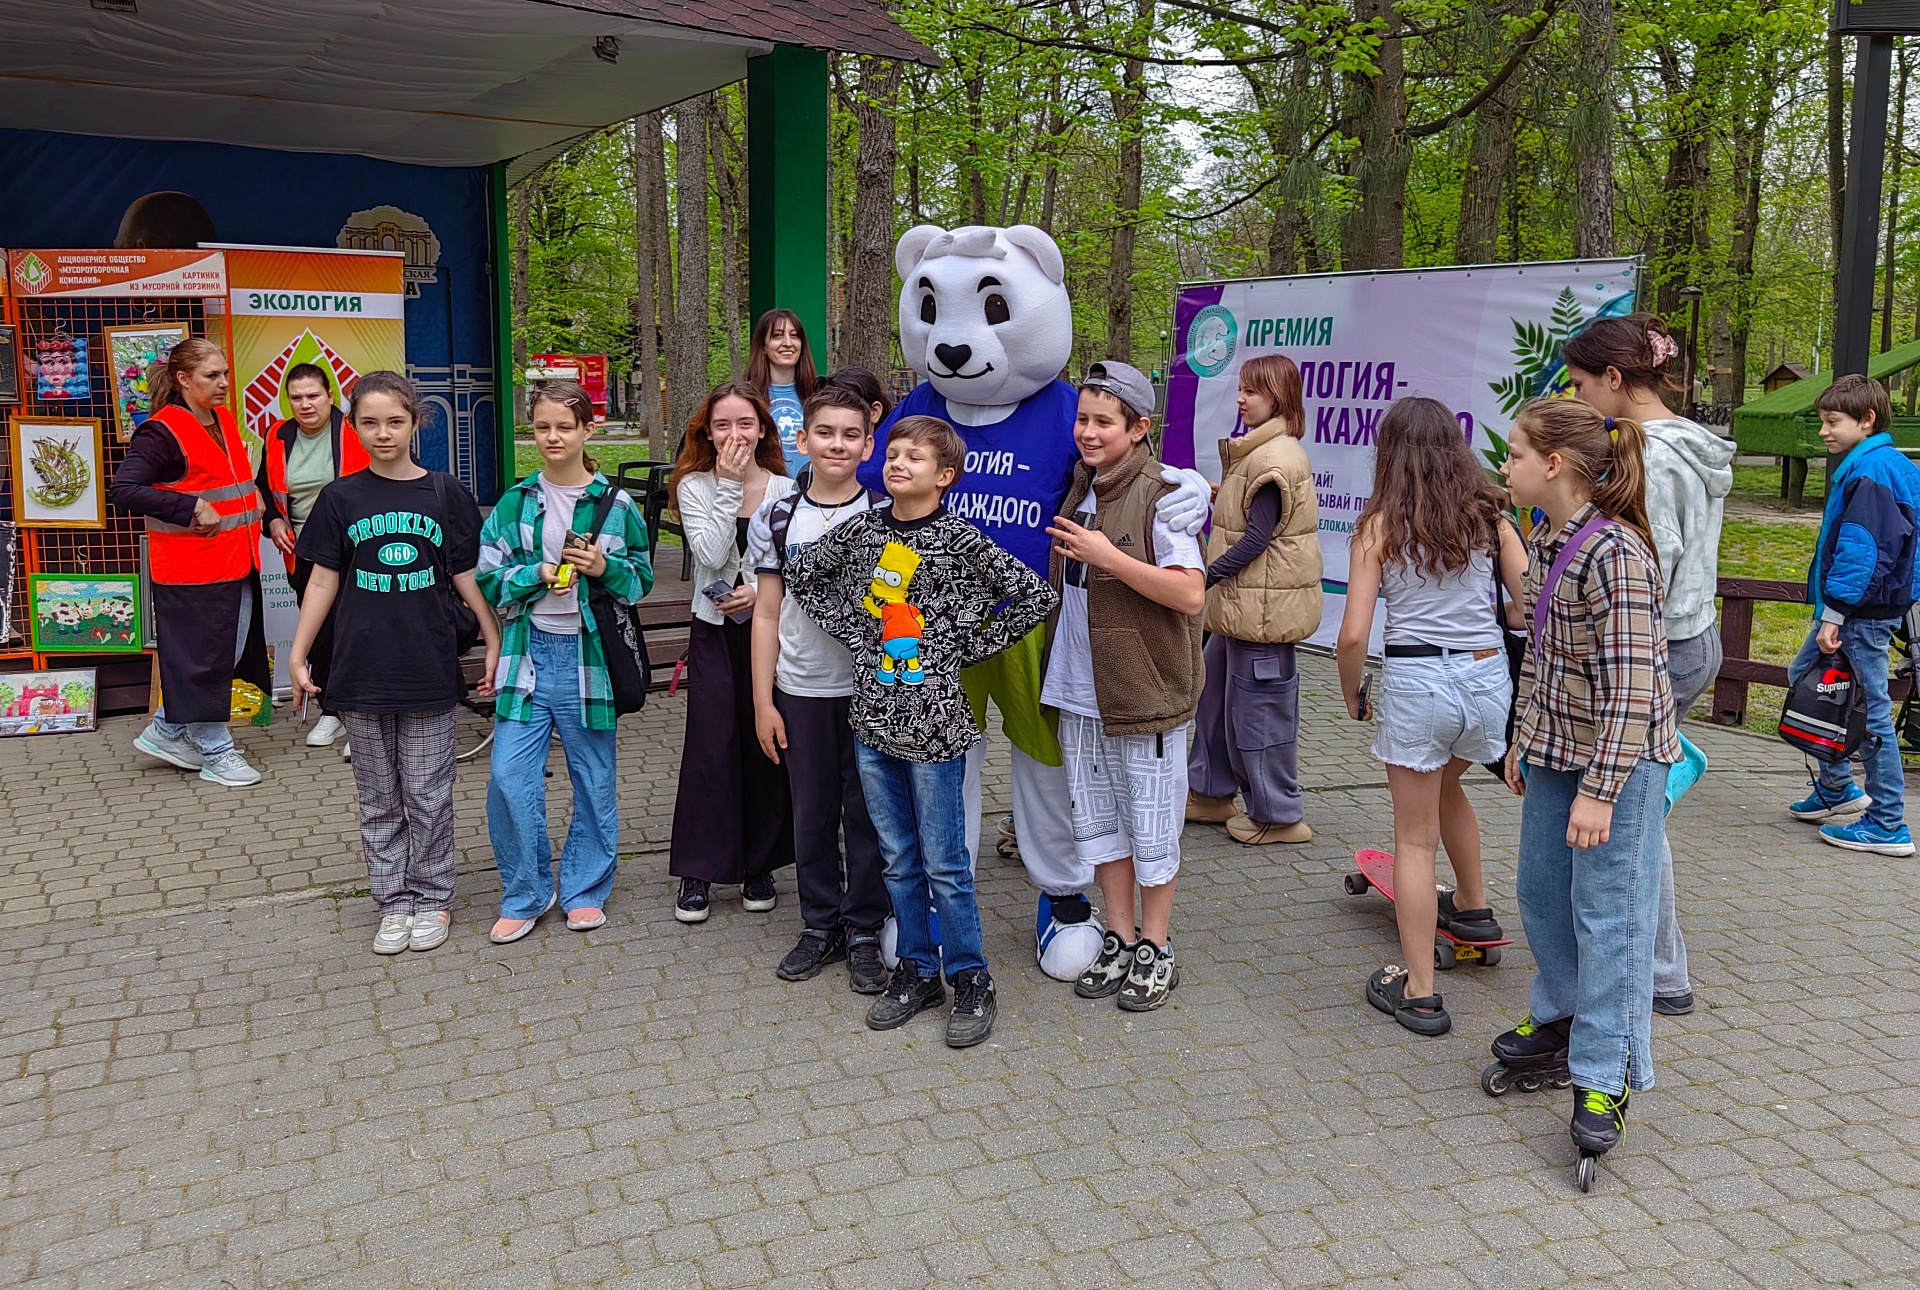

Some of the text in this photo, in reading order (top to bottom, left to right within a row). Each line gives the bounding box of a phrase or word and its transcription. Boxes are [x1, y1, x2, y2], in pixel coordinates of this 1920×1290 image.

[57, 255, 146, 264] АКЦИОНЕРНОЕ ОБЩЕСТВО
[58, 266, 130, 274] «МУСОРОУБОРОЧНАЯ
[182, 271, 220, 280] КАРТИНКИ
[404, 270, 430, 279] СКАЯ
[59, 276, 102, 285] КОМПАНИЯ»
[129, 281, 221, 291] ИЗ МУСОРНОЙ КОРЗИНКИ
[248, 293, 363, 313] ЭКОЛОГИЯ
[1245, 316, 1334, 347] ПРЕМИЯ
[1301, 361, 1408, 401] ЛОГИЯ-
[964, 451, 1014, 476] ОГИЯ
[1317, 493, 1351, 510] ЫВАЙ
[947, 492, 1042, 528] КАЖДОГО
[348, 511, 443, 547] BROOKLYN
[261, 573, 288, 583] дряе
[356, 569, 392, 593] NEW
[263, 586, 296, 596] тходо
[270, 600, 296, 609] экол
[1816, 681, 1850, 694] Suprem
